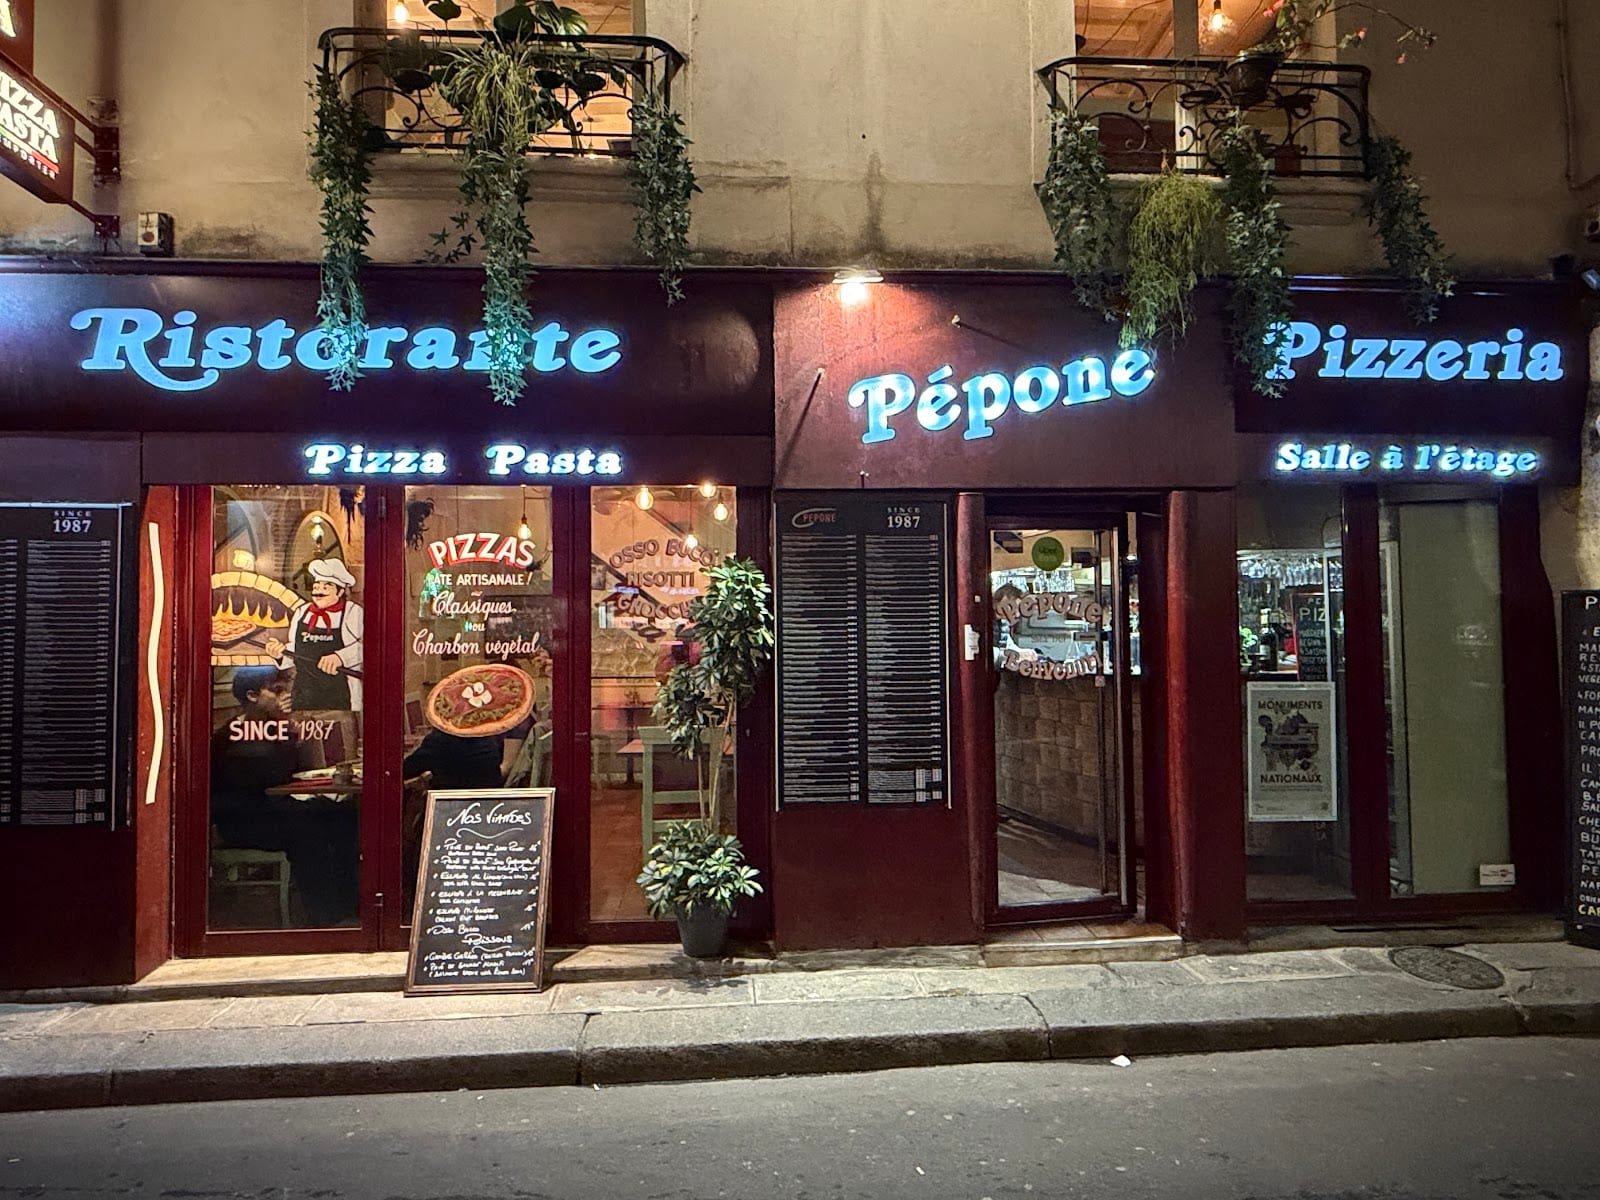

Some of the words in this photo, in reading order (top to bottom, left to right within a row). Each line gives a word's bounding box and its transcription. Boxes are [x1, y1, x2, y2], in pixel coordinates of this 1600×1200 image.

[0, 71, 60, 138] IZZA
[0, 102, 58, 163] ASTA
[1262, 321, 1564, 381] Pizzeria
[849, 350, 1155, 443] Pépone
[305, 445, 447, 474] Pizza
[487, 445, 622, 474] Pasta
[1277, 445, 1371, 471] Salle
[1381, 446, 1403, 470] à
[53, 520, 91, 532] 1987
[887, 516, 920, 528] 1987
[428, 533, 536, 569] PIZZAS
[609, 539, 659, 568] OSSO
[429, 573, 453, 586] ATE
[456, 573, 524, 586] ARTISANALE
[626, 571, 695, 587] RISOTTI
[432, 591, 517, 620] Classiques
[617, 597, 691, 619] GNOCCH
[413, 629, 480, 656] Charbon
[1580, 643, 1600, 653] MA
[1580, 653, 1600, 663] RE
[1258, 700, 1323, 711] MONUMENTS
[229, 720, 289, 741] SINCE
[1581, 731, 1600, 740] CA
[1260, 774, 1321, 784] NATIONAUX
[447, 803, 482, 827] Nos
